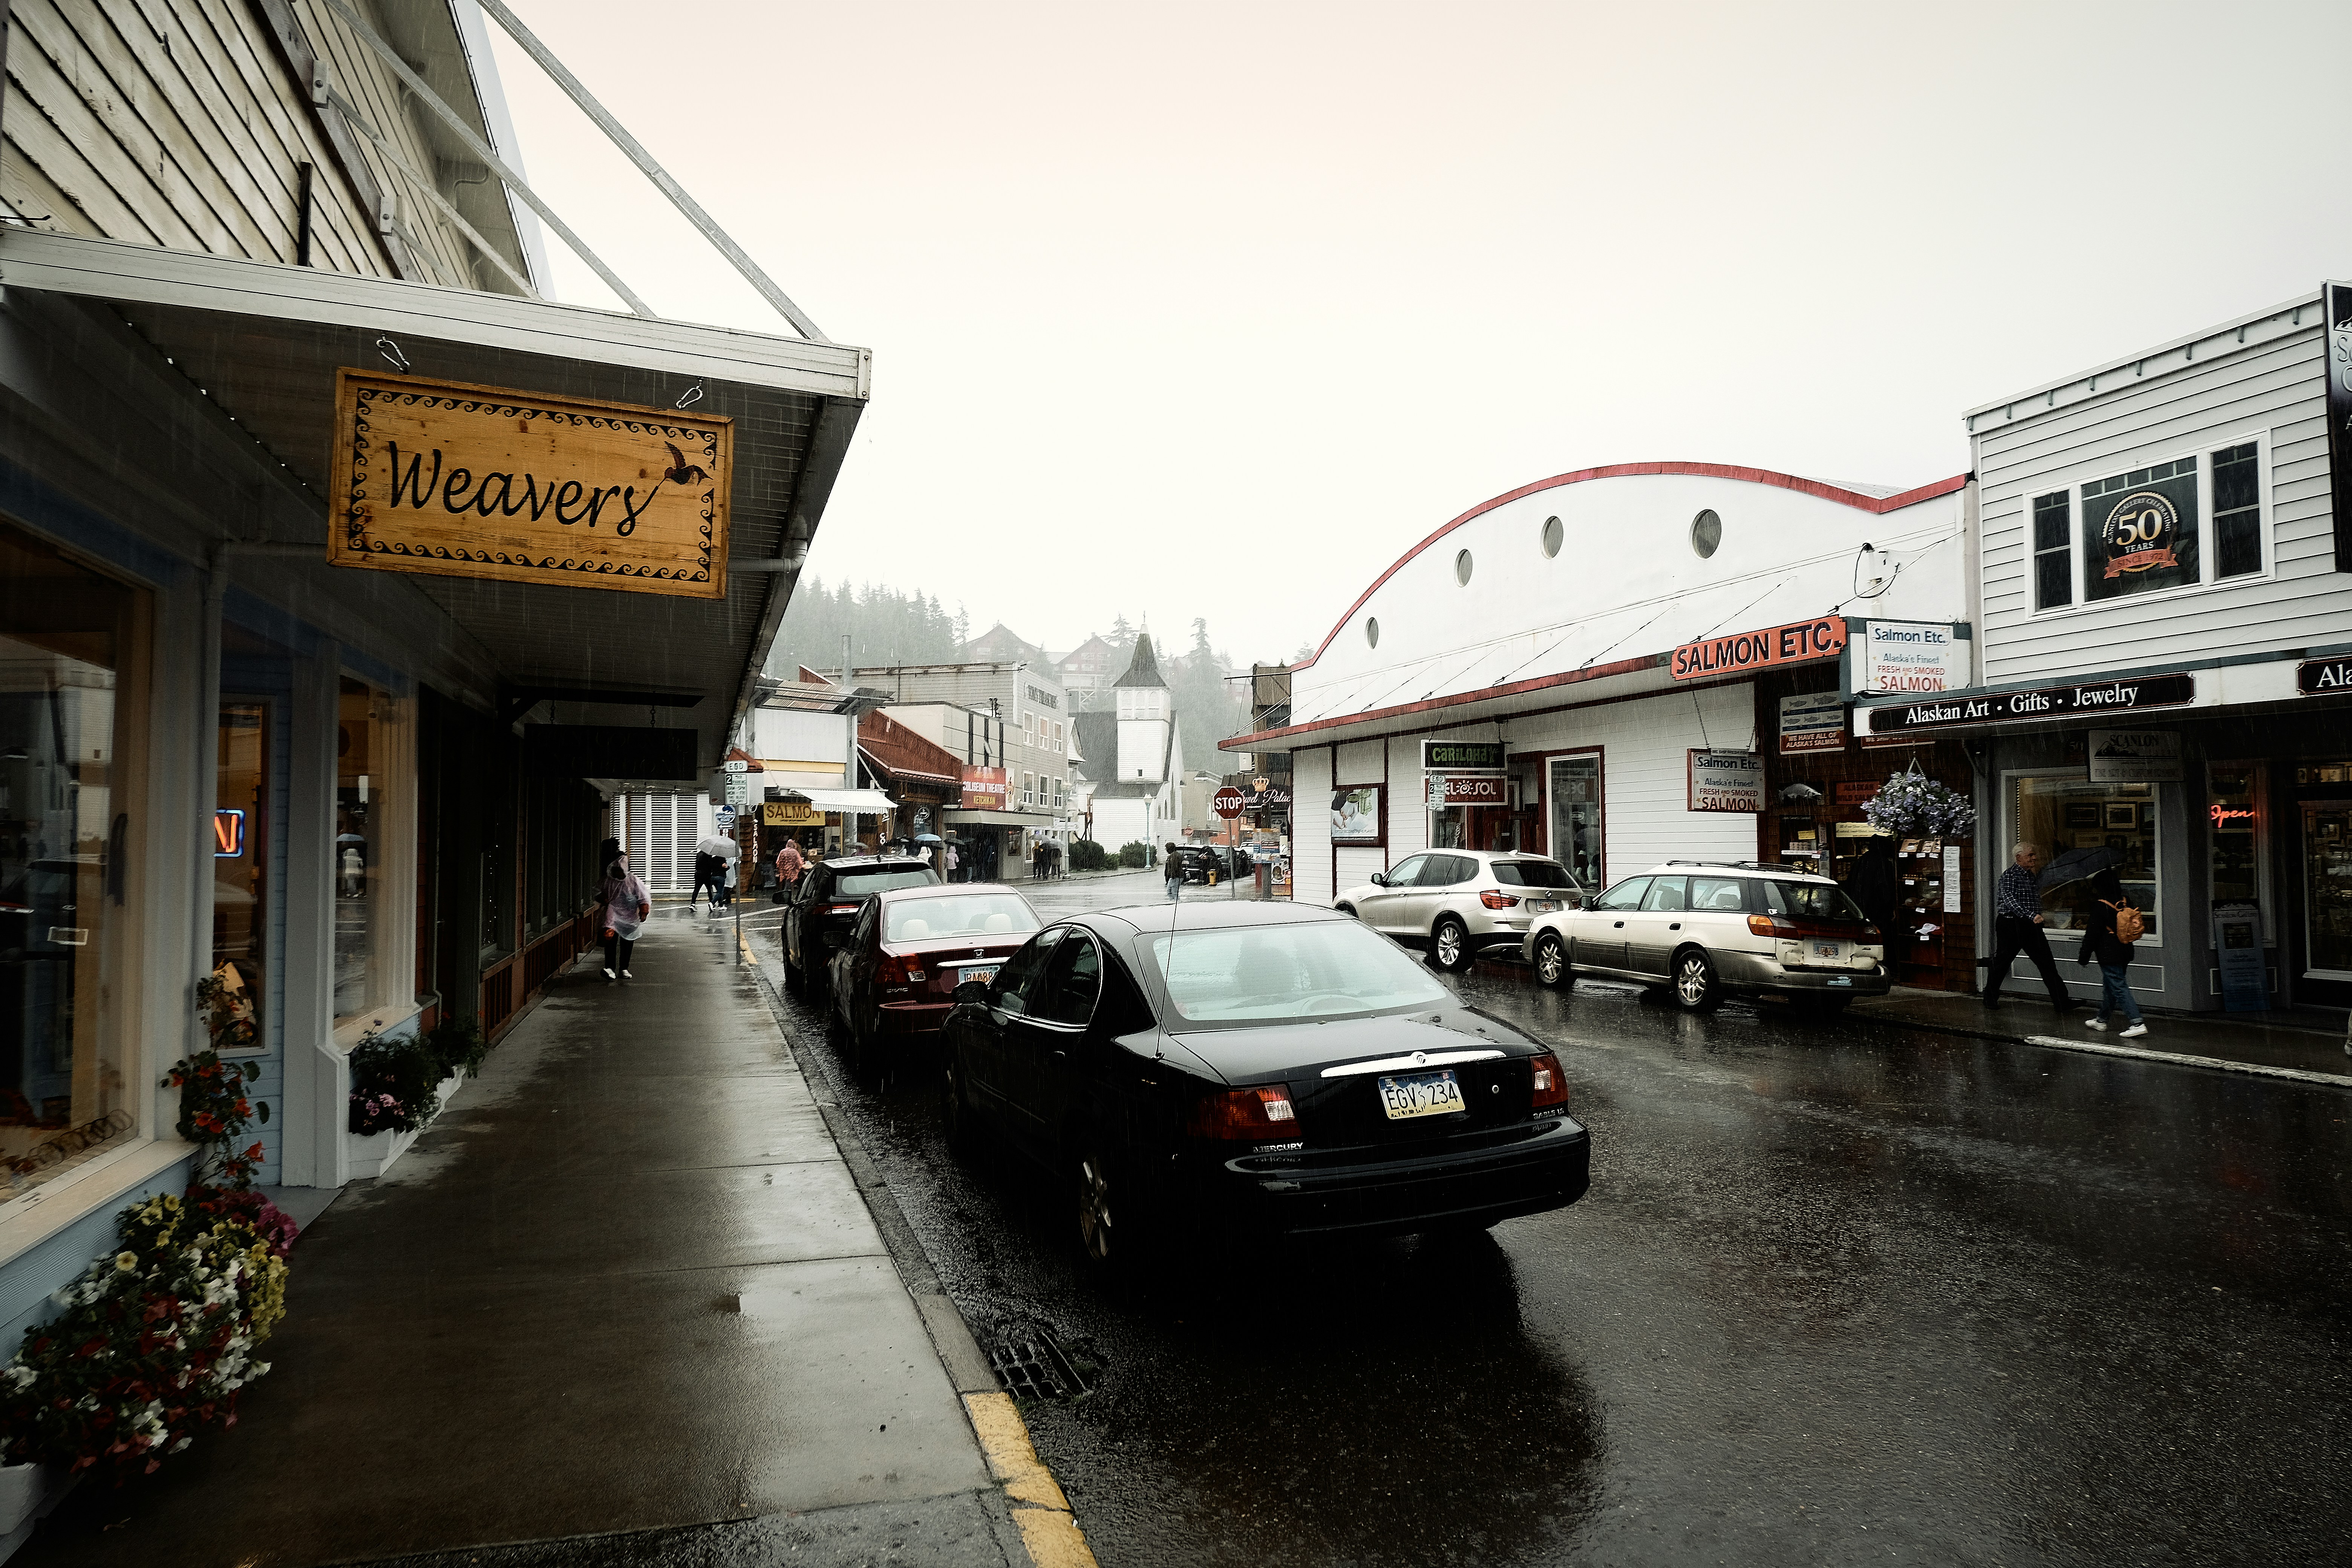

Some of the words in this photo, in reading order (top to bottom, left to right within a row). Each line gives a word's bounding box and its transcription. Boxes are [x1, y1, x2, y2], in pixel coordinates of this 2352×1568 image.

[388, 440, 660, 537] Weavers
[2116, 509, 2162, 545] 50
[2125, 541, 2154, 553] YEARS
[2117, 555, 2142, 567] SINCE
[1875, 628, 1920, 642] Salmon
[1925, 631, 1946, 643] Etc.
[1676, 632, 1770, 676] SALMON
[1780, 622, 1842, 659] ETC.
[1883, 653, 1915, 663] Alaska's
[1914, 667, 1945, 675] SMOKED
[1880, 675, 1942, 691] SALMON
[1905, 704, 1961, 724] Alaskan
[1963, 701, 1990, 718] Art
[2010, 693, 2049, 713] Gifts
[2073, 683, 2139, 707] Jewelry
[1698, 756, 1737, 769] Salmon
[1741, 759, 1761, 770] Etc.
[726, 775, 732, 784] 2
[1704, 778, 1732, 786] Alaska's
[962, 781, 986, 792] COLISEUM
[986, 783, 1005, 794] THEATRE
[1445, 782, 1457, 795] EL
[1472, 782, 1496, 795] SOL
[973, 795, 996, 805] KETCHIKAN
[1263, 789, 1291, 803] Palac
[1215, 797, 1242, 810] STOP
[1702, 797, 1756, 810] SALMON
[766, 804, 821, 819] SALMON
[2211, 805, 2256, 828] Open
[1253, 1142, 1303, 1153] MERCURY
